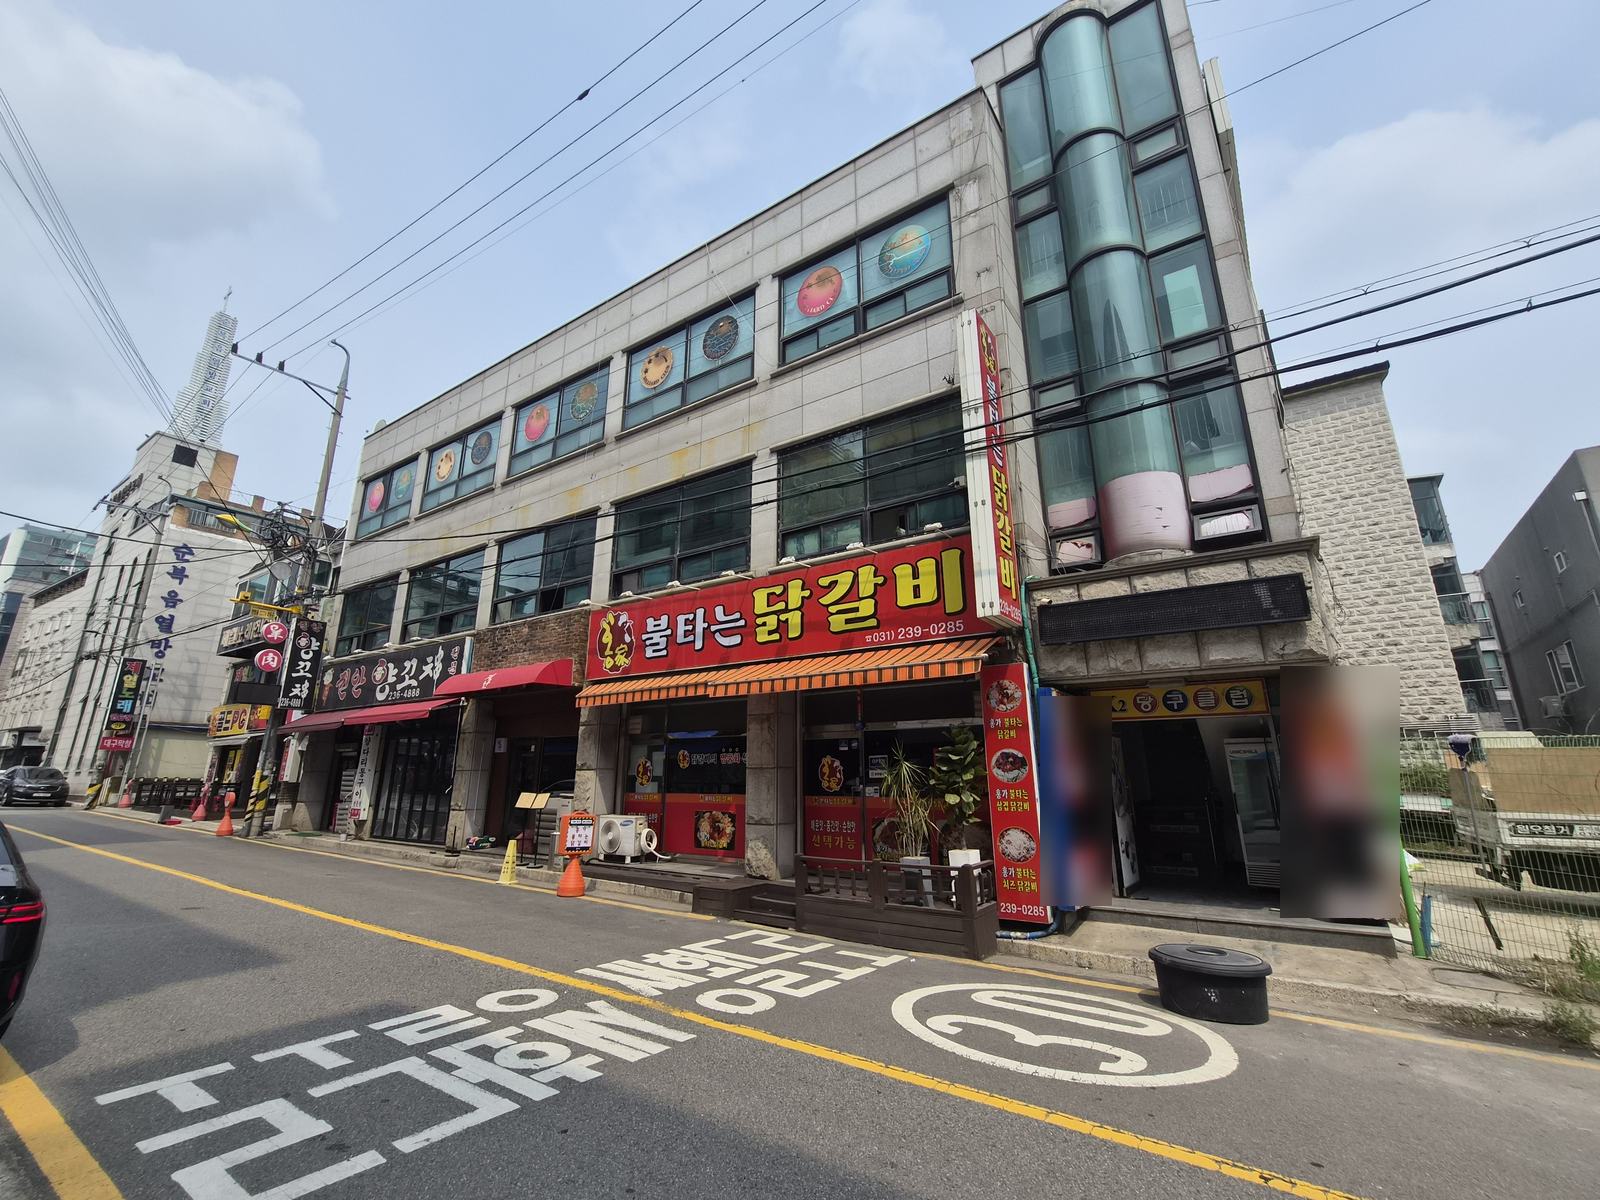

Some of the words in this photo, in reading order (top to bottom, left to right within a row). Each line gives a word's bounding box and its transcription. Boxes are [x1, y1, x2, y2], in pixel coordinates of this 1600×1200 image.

[991, 464, 1017, 601] 닭갈비
[641, 604, 746, 659] 불타는
[752, 548, 965, 644] 닭갈비
[872, 630, 895, 643] 031)
[897, 618, 965, 641] 239-0285
[812, 835, 857, 850] 선택가능
[1000, 902, 1045, 917] 239-0285
[926, 990, 1172, 1074] 30
